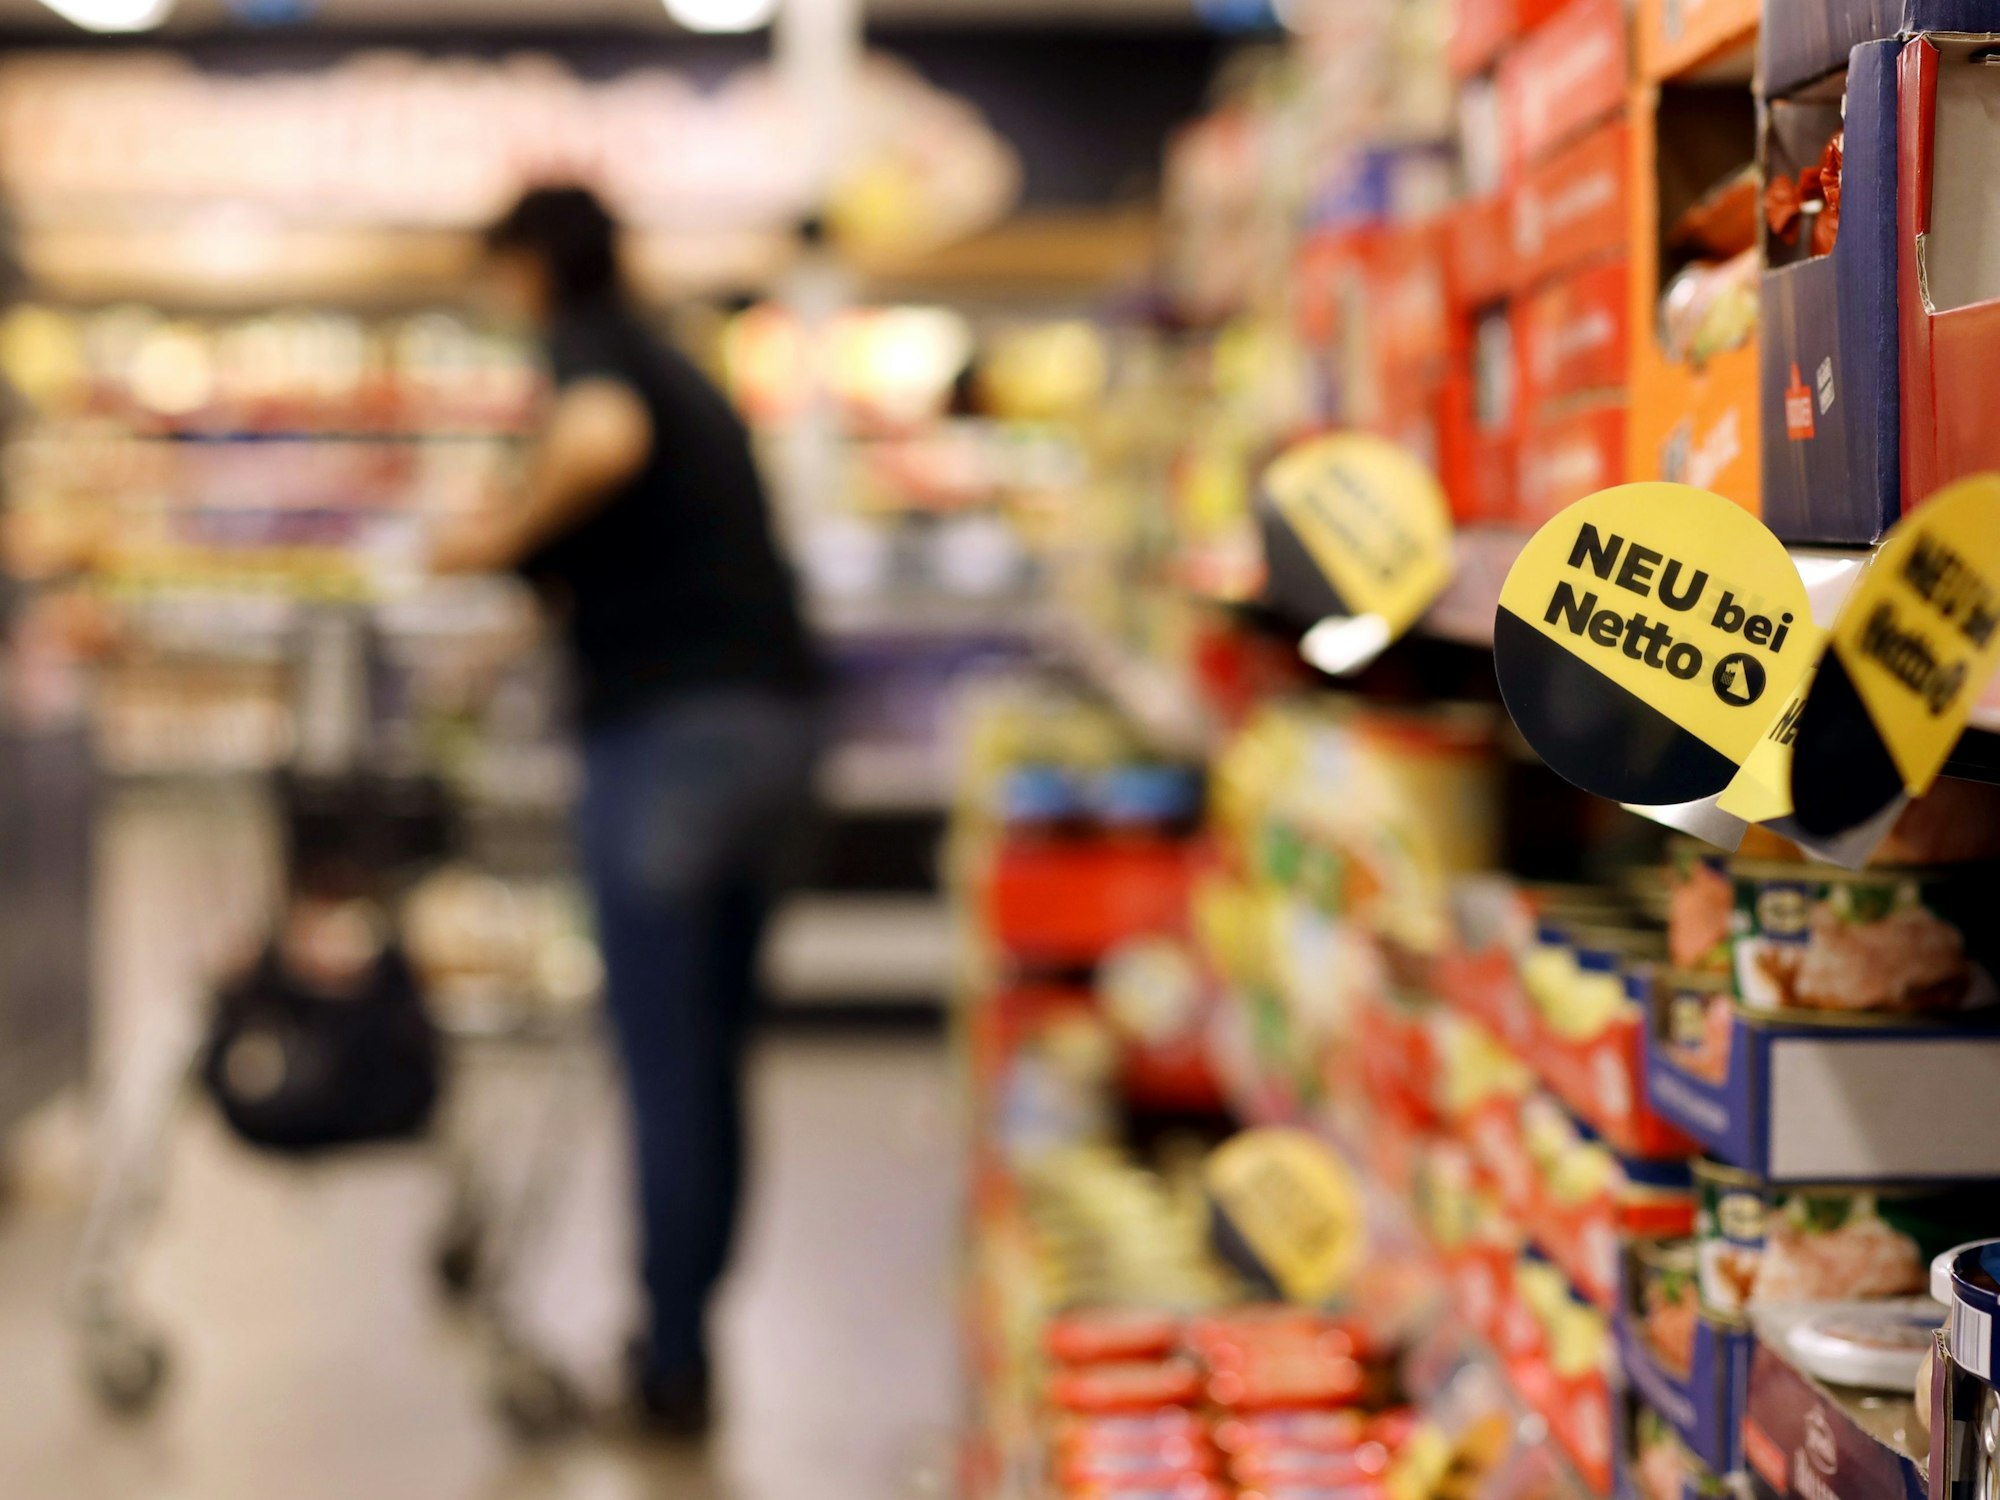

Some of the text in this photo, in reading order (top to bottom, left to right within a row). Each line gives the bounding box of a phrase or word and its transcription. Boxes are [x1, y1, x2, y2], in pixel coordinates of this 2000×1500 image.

[1543, 580, 1703, 680] Netto
[1567, 522, 1794, 654] NEU bei
